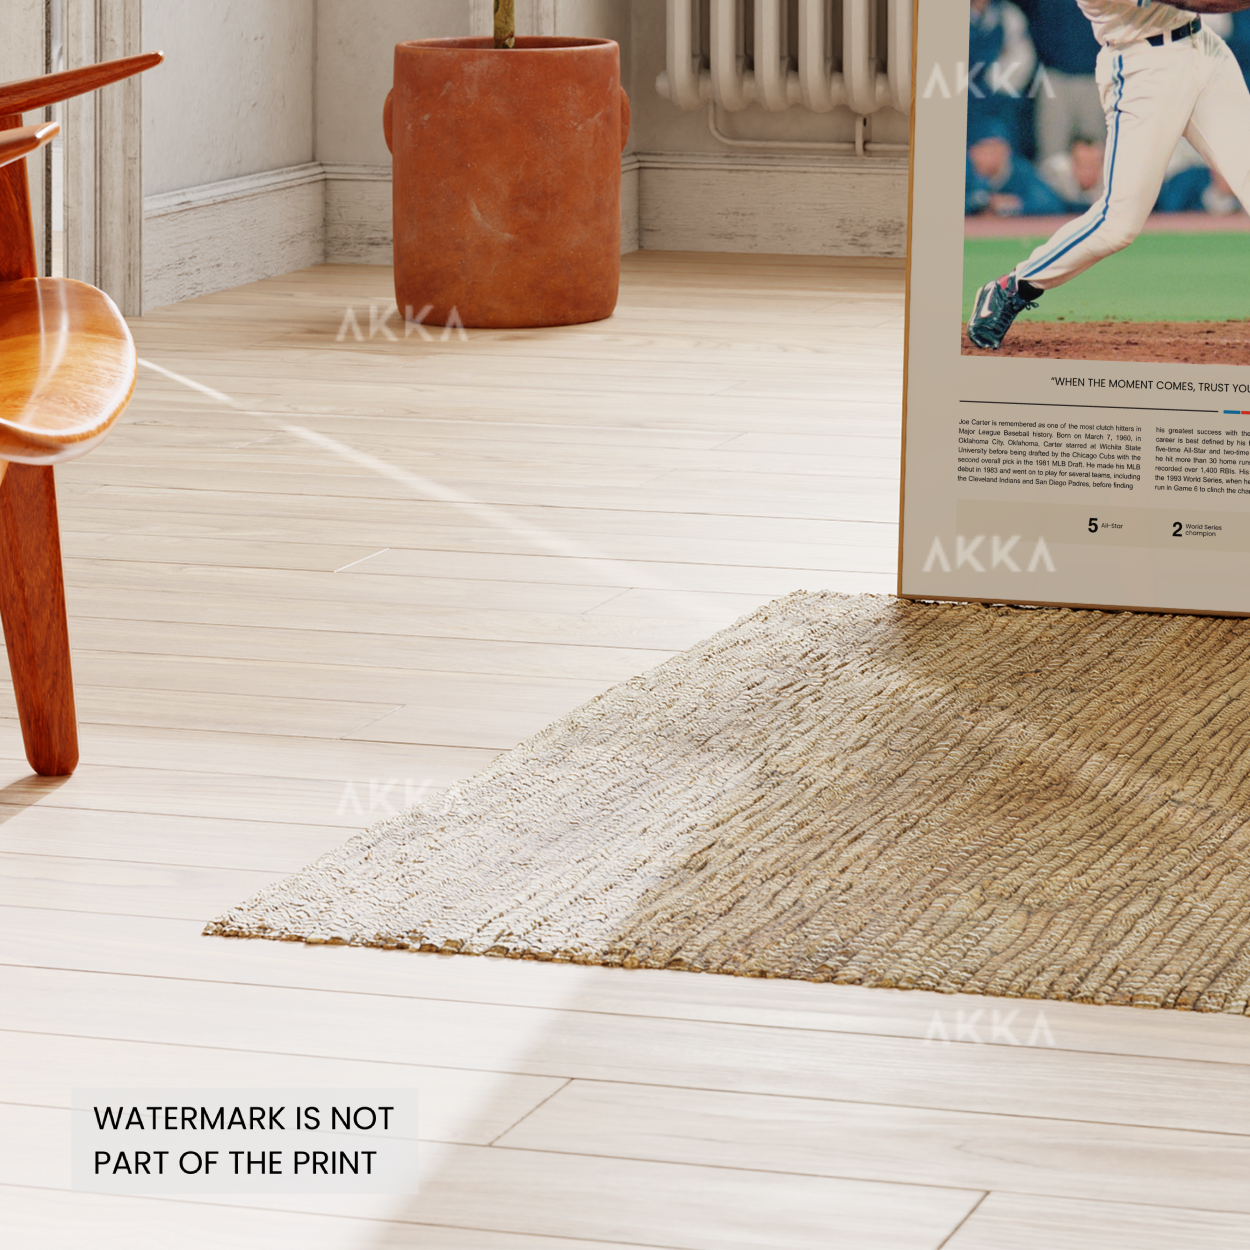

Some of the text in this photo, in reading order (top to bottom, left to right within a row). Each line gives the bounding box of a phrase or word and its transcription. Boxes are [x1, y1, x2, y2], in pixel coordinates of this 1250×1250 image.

[1050, 376, 1084, 386] “WHEN
[1087, 377, 1106, 387] THE
[1108, 379, 1153, 389] MOMENT
[1156, 380, 1195, 392] COMES,
[1198, 382, 1230, 392] TRUST
[970, 418, 990, 426] Carter
[991, 419, 997, 427] is
[998, 420, 1036, 428] remembered
[1115, 424, 1134, 432] hitters
[1155, 426, 1165, 434] his
[1224, 429, 1238, 437] with
[1087, 517, 1098, 533] 5
[1171, 521, 1182, 537] 2
[1184, 529, 1216, 537] champion
